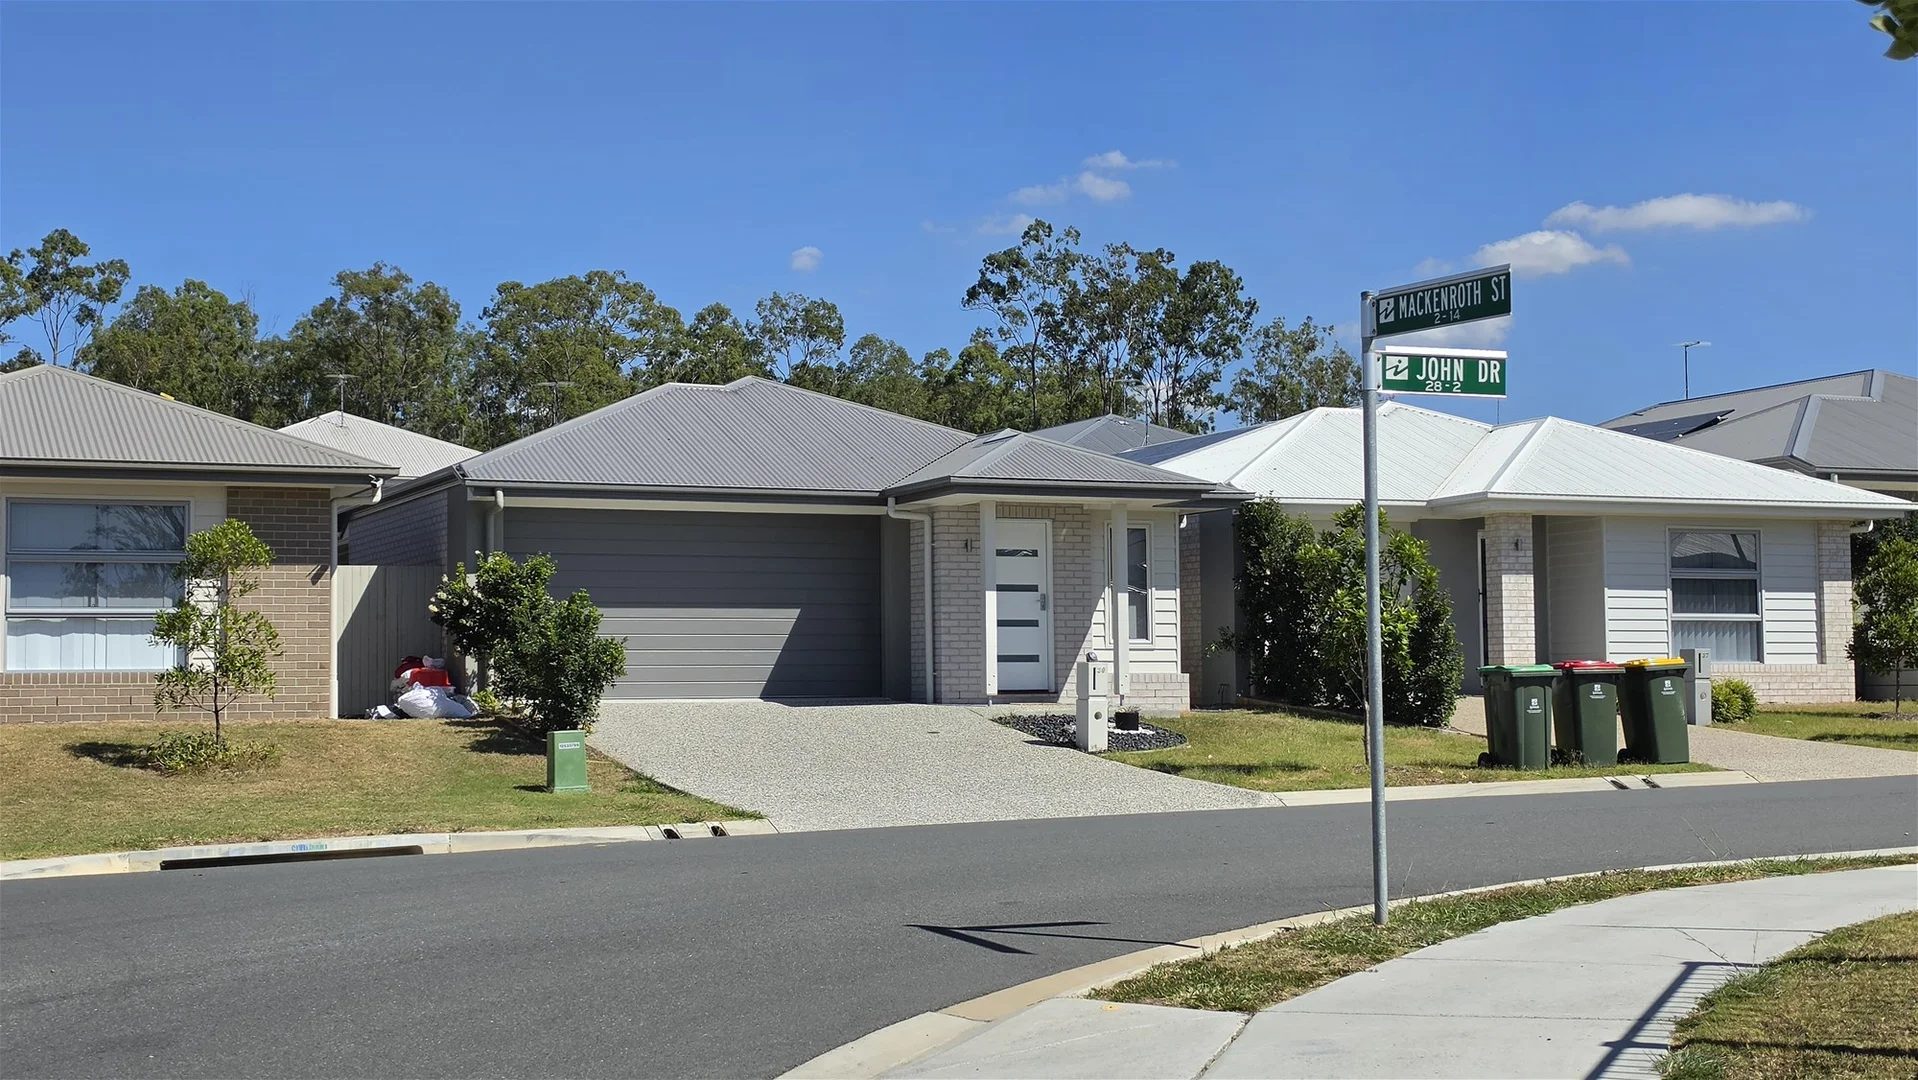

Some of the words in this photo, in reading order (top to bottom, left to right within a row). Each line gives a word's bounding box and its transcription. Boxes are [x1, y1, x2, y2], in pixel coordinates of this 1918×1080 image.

[1399, 280, 1481, 319] MACKENROTH
[1491, 275, 1506, 302] ST
[1416, 357, 1464, 382] JOHN
[1478, 360, 1500, 383] DR
